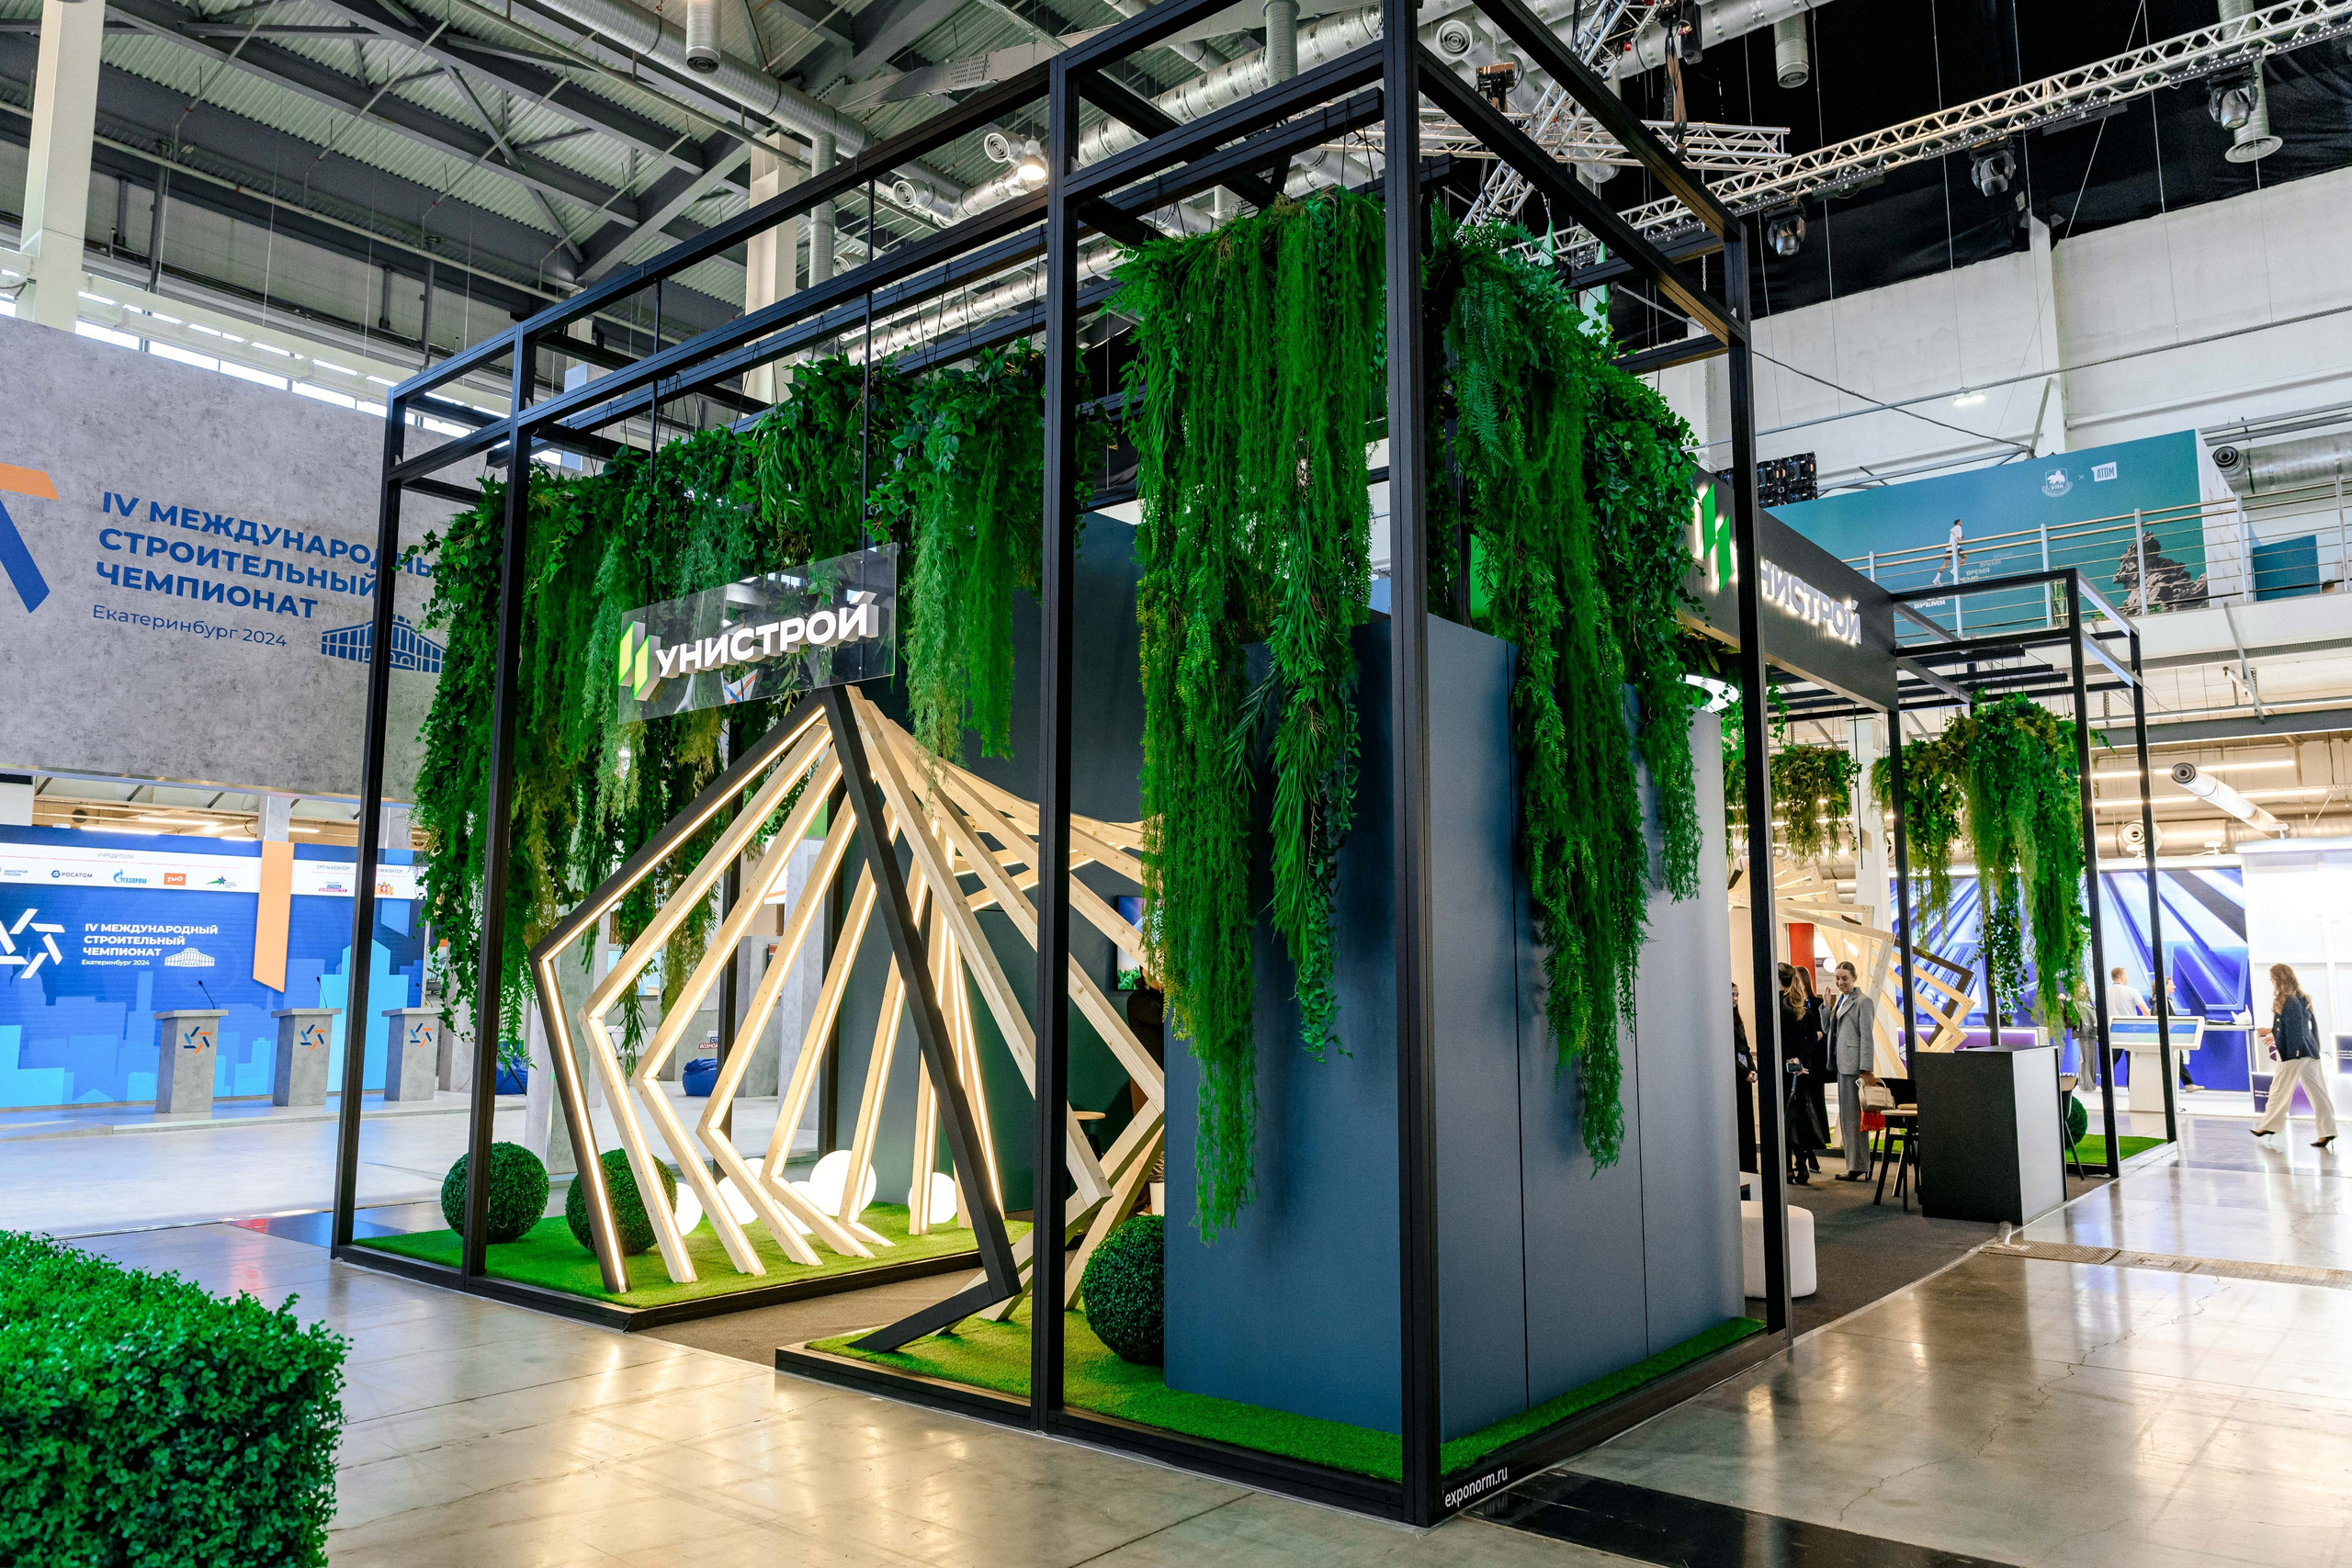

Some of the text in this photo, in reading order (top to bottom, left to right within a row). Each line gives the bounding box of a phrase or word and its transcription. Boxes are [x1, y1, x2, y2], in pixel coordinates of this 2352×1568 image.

[102, 491, 141, 517] IV
[98, 528, 378, 600] СТРОИТЕЛЬНЫЙ
[1965, 568, 1990, 576] ВРЕМЯ
[96, 561, 319, 619] ЧЕМПИОНАТ
[1760, 559, 1862, 645] НИСТРОЙ
[1914, 600, 1946, 609] ВРЕМЯ
[92, 604, 288, 648] Екатеринбург 2024
[655, 591, 877, 678] УНИСТРОЙ
[84, 935, 186, 946] СТРОИТЕЛЬНЫЙ
[85, 923, 219, 935] IV МЕЖДУНАРОДНЫЙ
[81, 959, 132, 967] Екатеринбург
[83, 947, 163, 957] ЧЕМПИОНАТ
[1445, 1467, 1508, 1507] exponorm.ru
